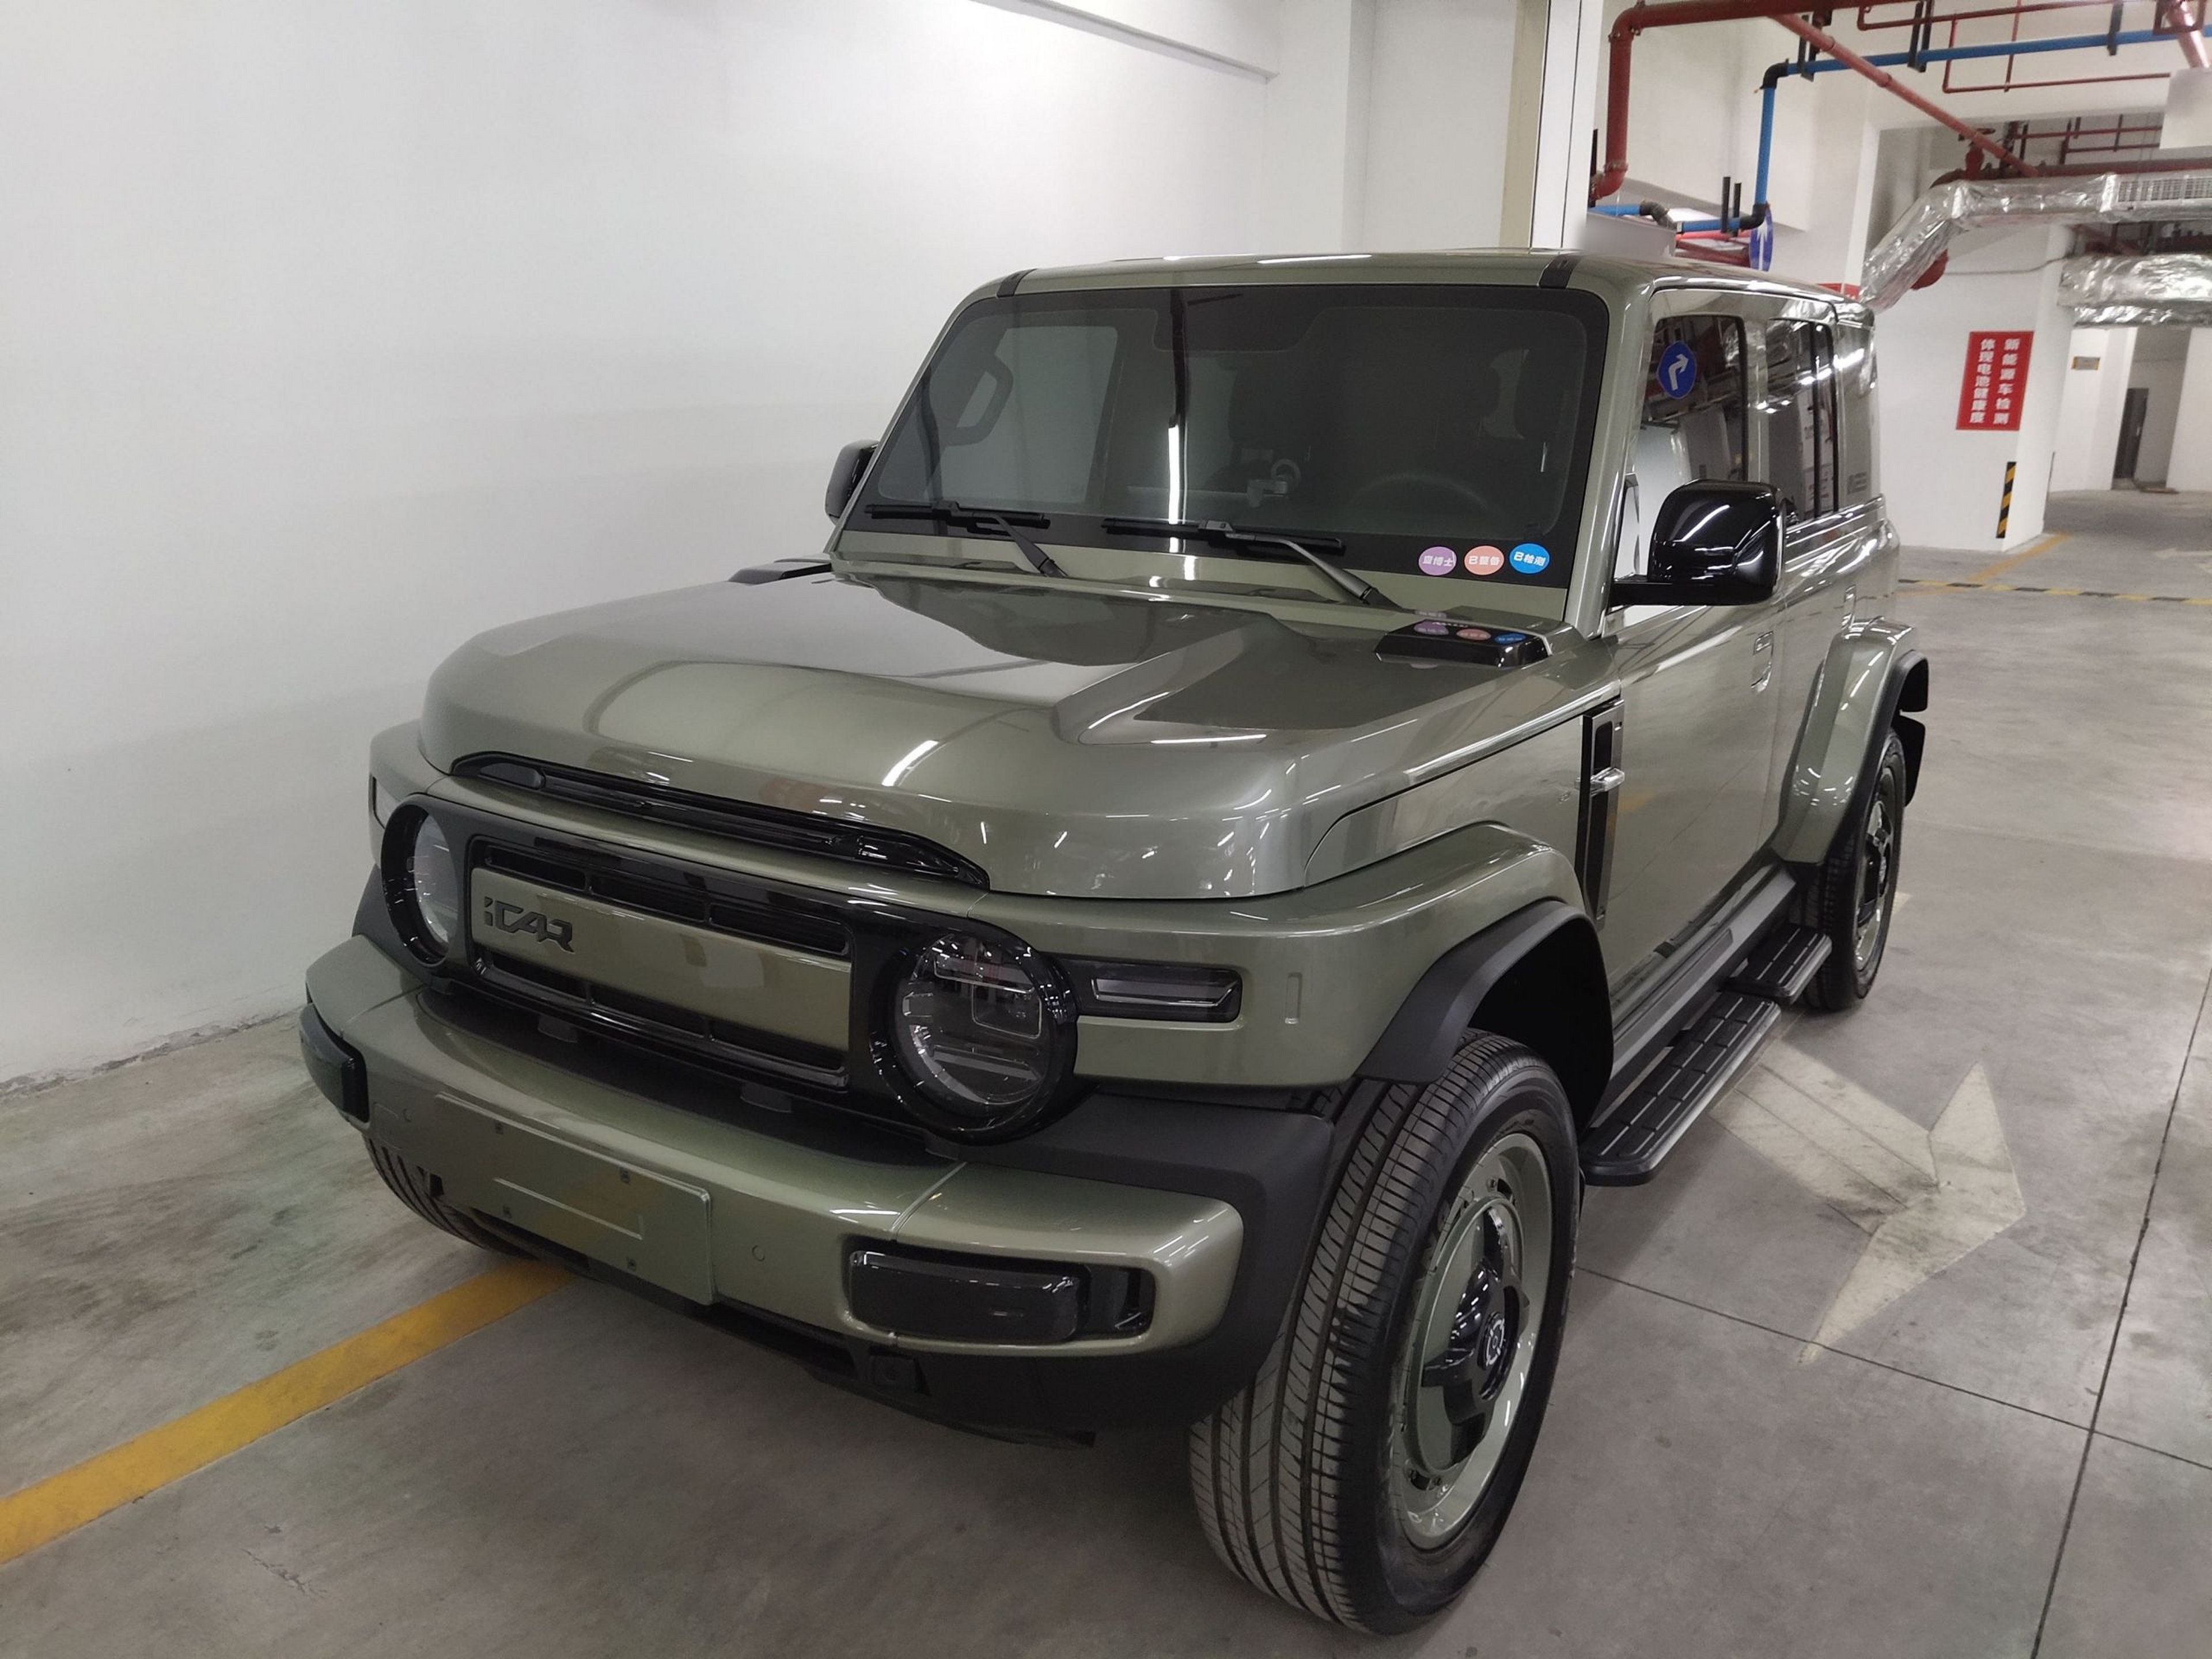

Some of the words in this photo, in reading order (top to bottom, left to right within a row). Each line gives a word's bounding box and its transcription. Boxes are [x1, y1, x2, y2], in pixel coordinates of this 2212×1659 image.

[1993, 338, 2021, 425] 新能源车检测
[1422, 555, 1453, 567] 查博士
[1513, 551, 1546, 567] 已检测
[484, 896, 575, 953] iCAR
